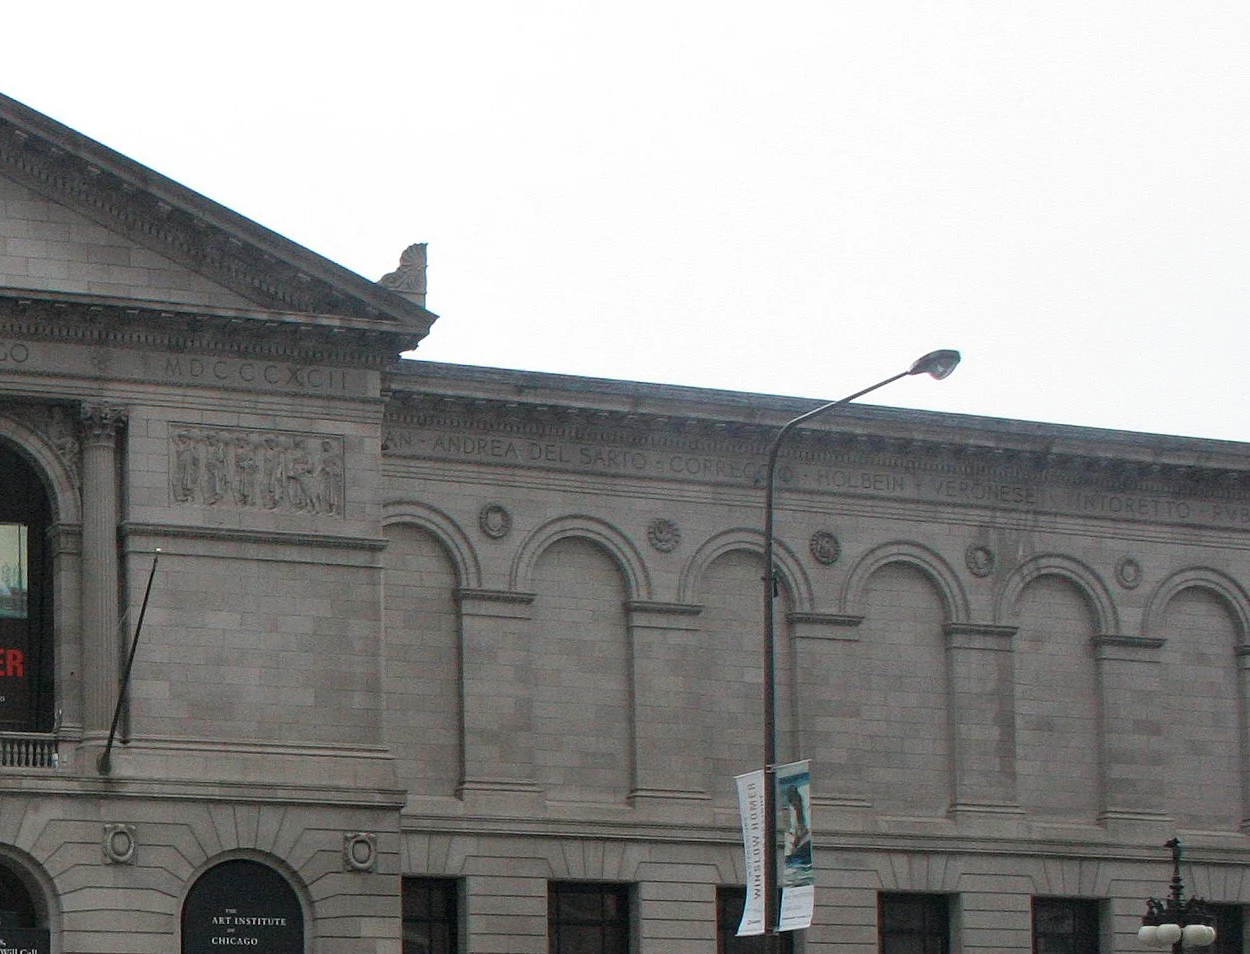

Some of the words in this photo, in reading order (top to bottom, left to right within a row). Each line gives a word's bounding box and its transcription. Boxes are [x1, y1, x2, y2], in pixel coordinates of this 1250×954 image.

[431, 436, 519, 459] ANDREA
[529, 443, 571, 463] DEL
[579, 447, 648, 471] SARTO
[669, 456, 794, 485] CORREGGO
[816, 469, 905, 491] HOLBEIN
[748, 782, 759, 831] HOMER
[751, 835, 763, 900] WINSLOW
[211, 916, 232, 925] ART
[234, 917, 287, 926] INSTITUTE
[211, 936, 259, 946] CHICAGO
